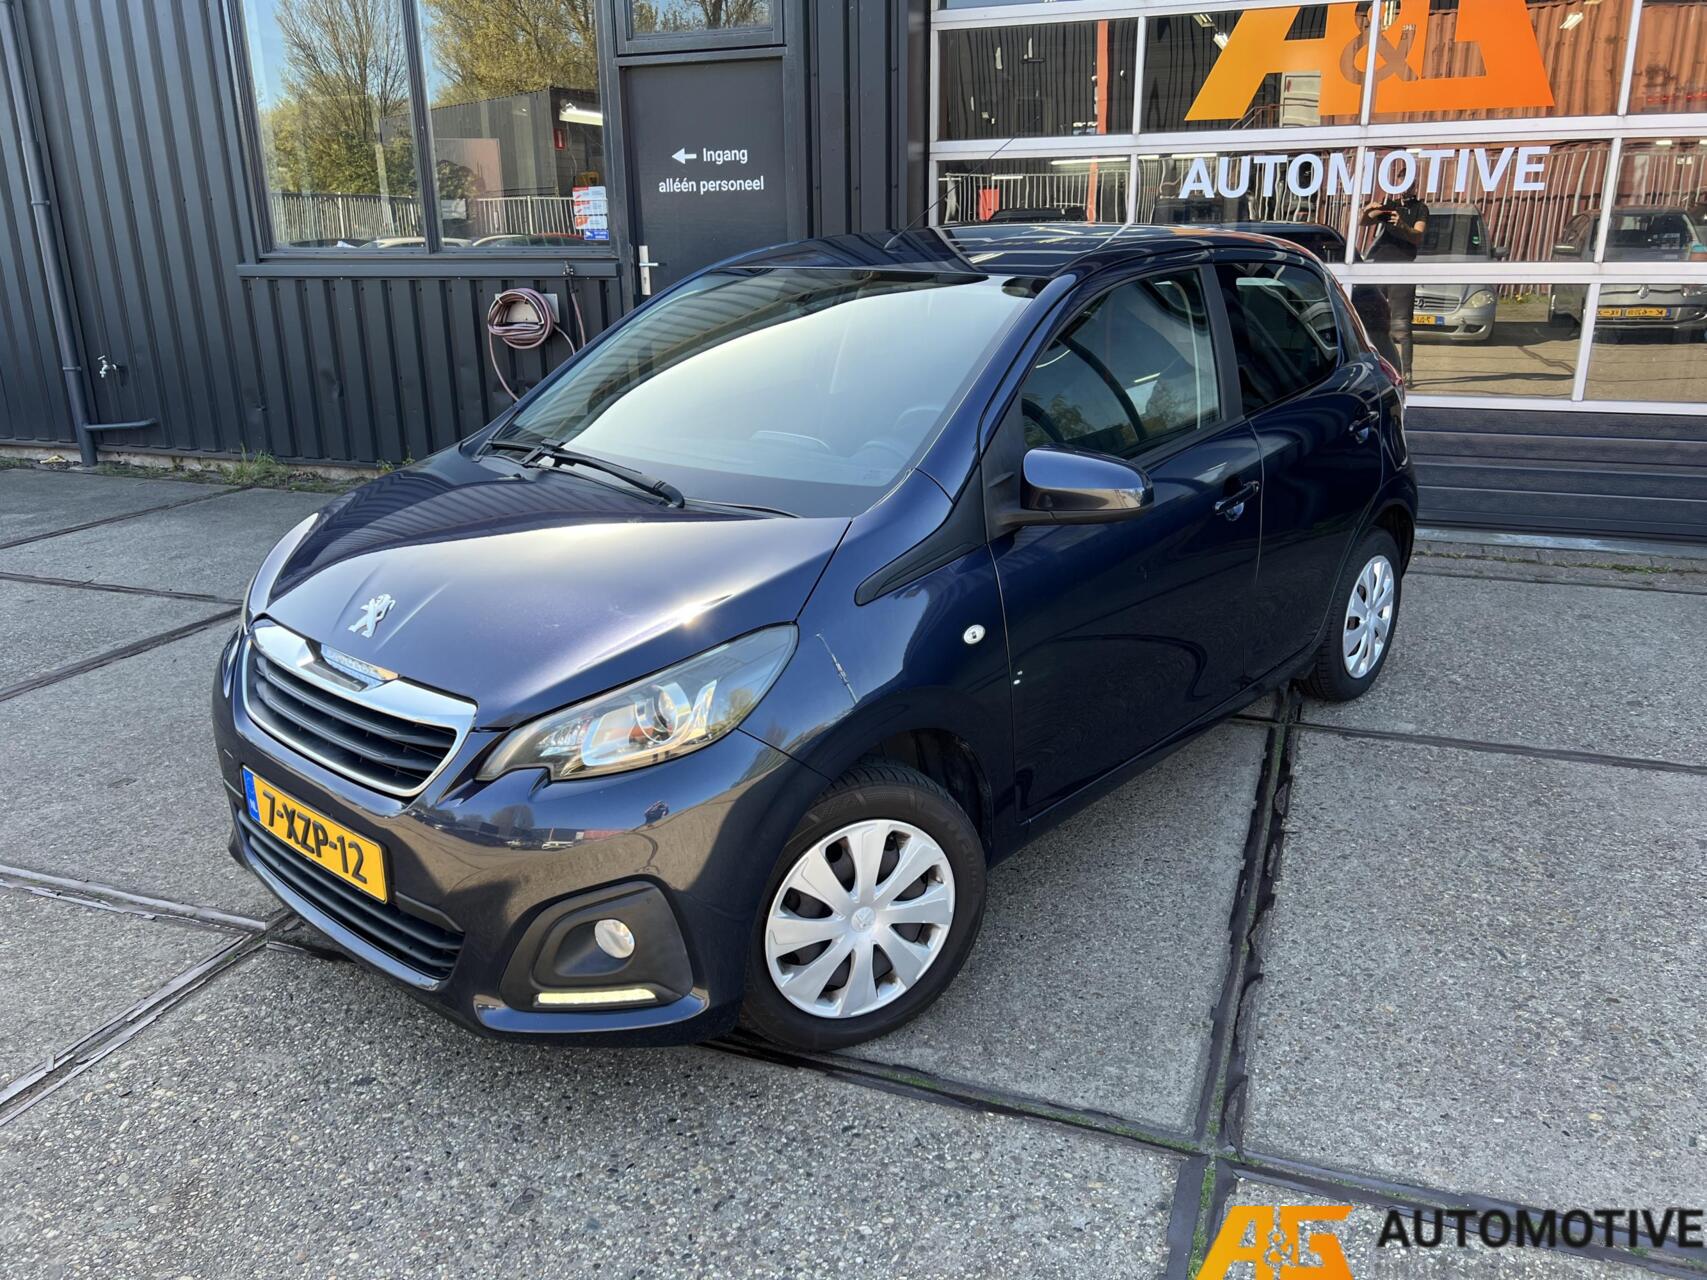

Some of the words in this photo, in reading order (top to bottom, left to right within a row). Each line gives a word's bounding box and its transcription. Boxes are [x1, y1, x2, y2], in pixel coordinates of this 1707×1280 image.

[702, 147, 748, 165] Ingang
[1178, 146, 1551, 199] AUTOMOTIVE
[658, 177, 697, 193] alléén
[700, 175, 765, 195] personeel
[262, 789, 368, 884] 7-XZP-12
